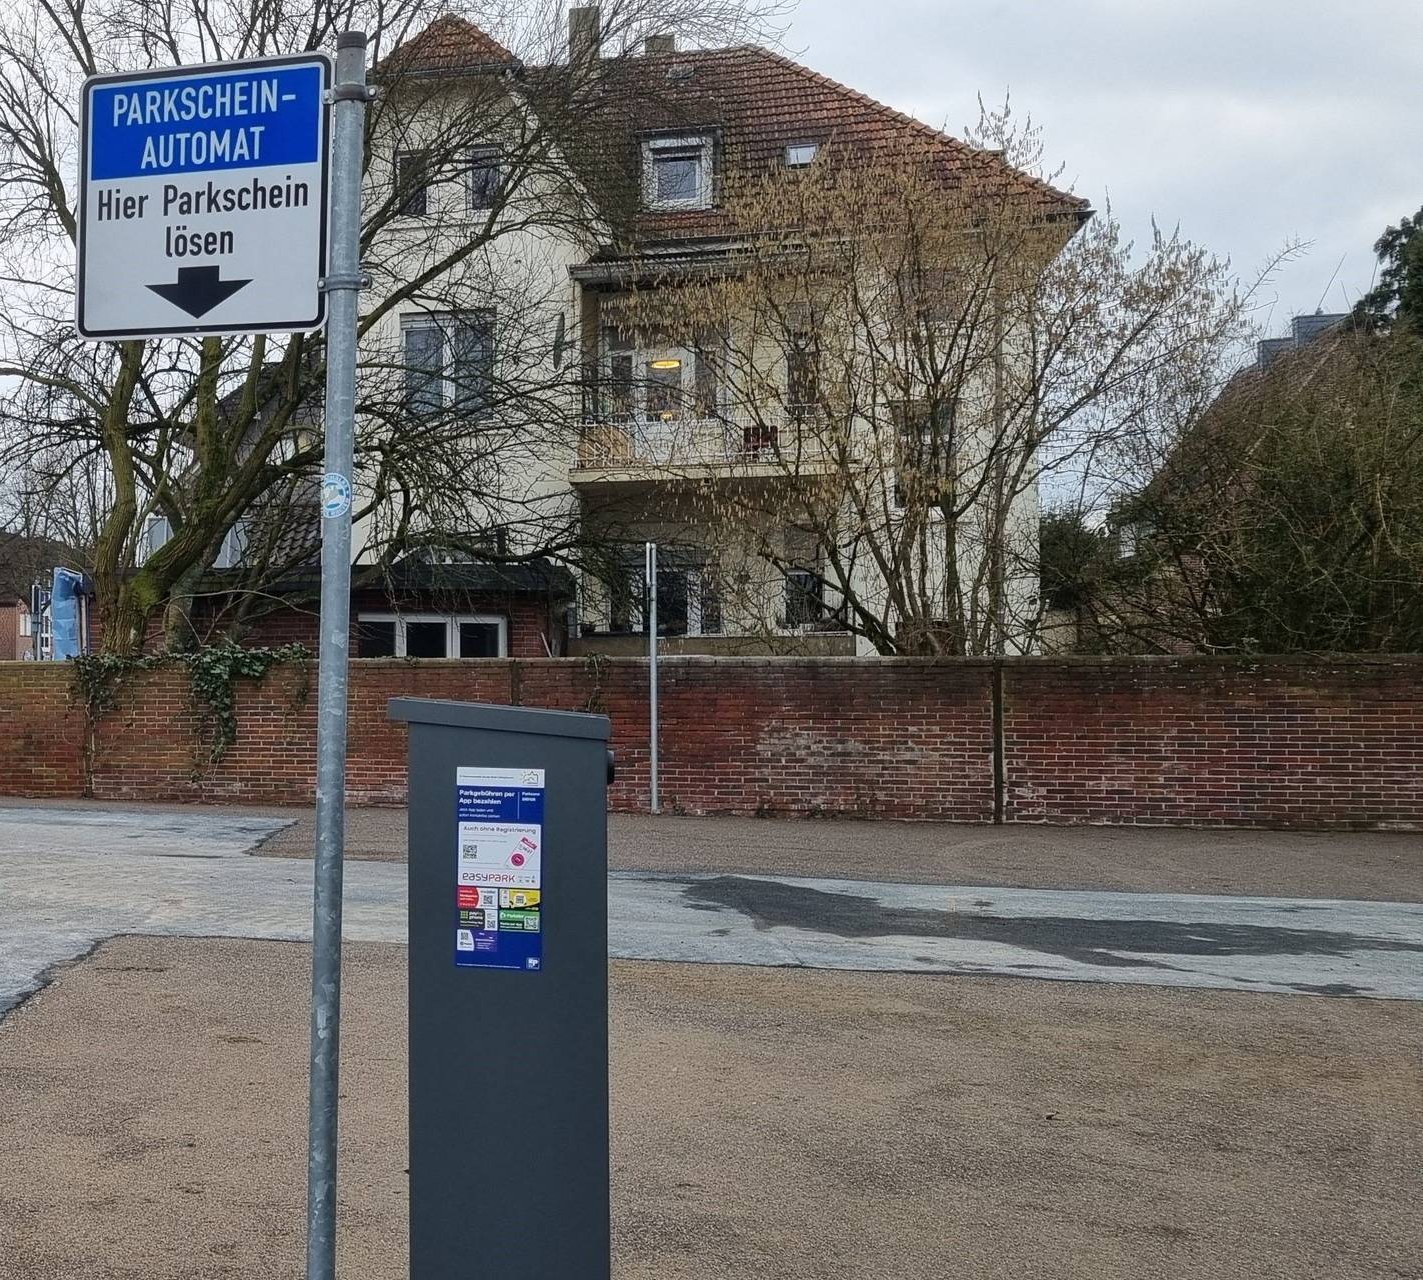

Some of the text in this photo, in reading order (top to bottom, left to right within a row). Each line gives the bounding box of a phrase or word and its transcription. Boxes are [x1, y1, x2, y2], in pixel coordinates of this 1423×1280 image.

[112, 78, 297, 128] PARKSCHEIN-
[140, 126, 266, 170] AUTOMAT
[97, 175, 309, 221] Hier Parkschein
[165, 225, 234, 258] lösen
